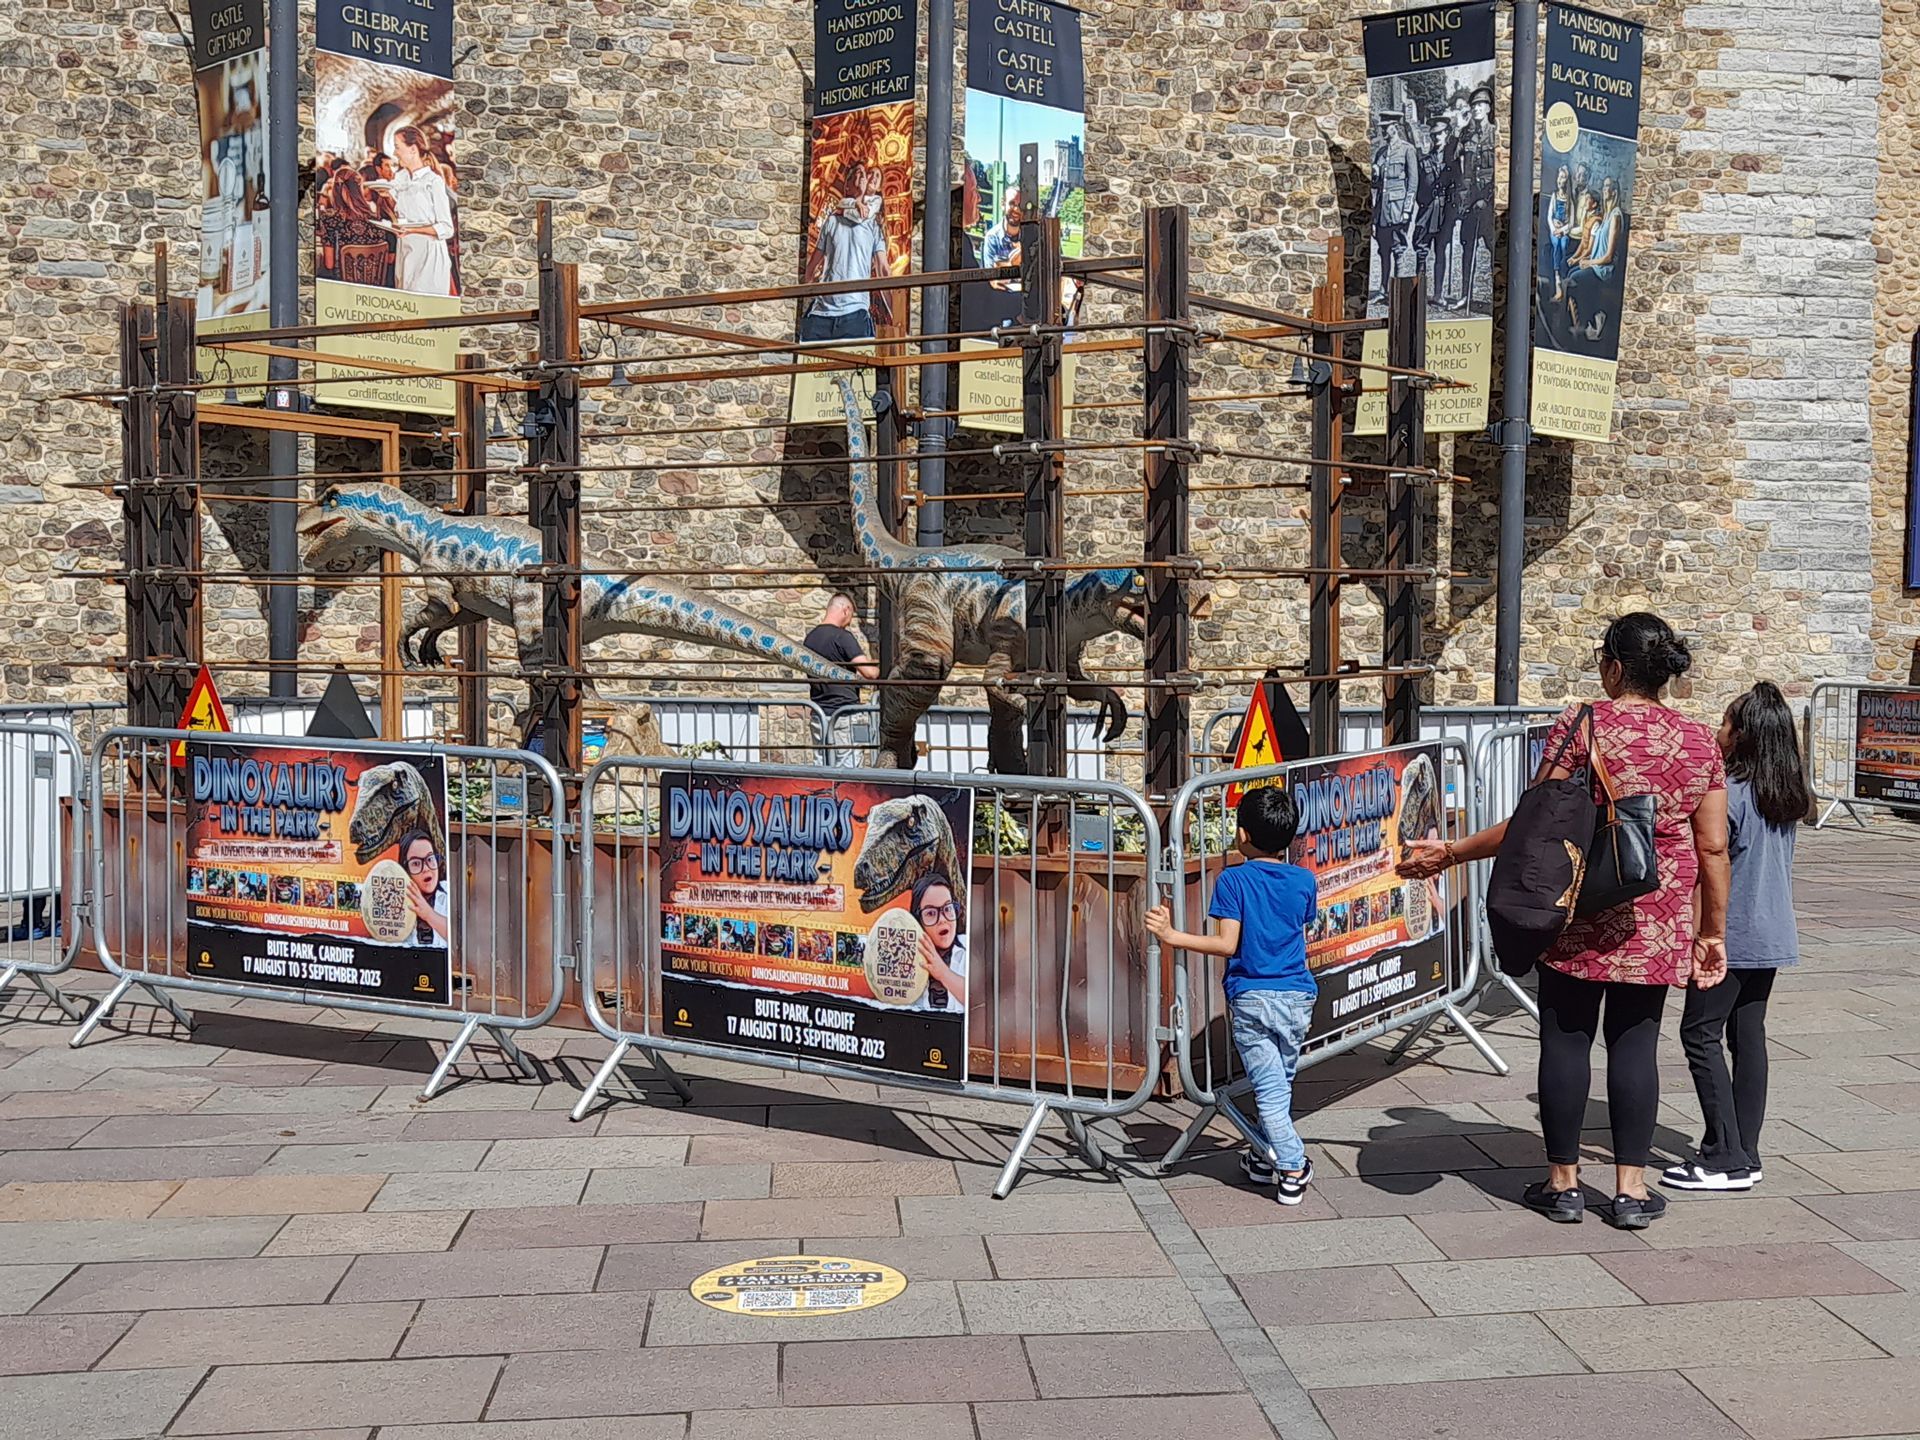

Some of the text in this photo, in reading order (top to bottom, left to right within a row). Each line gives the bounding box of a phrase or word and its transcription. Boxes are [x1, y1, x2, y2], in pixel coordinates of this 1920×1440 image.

[211, 5, 244, 30] CASTLE
[342, 6, 430, 42] CELEBRATE
[828, 5, 904, 34] HANESYDDOL
[1396, 8, 1461, 37] FIRING
[1559, 8, 1633, 43] HANESION Y
[208, 26, 252, 56] GIFT SHOP
[835, 27, 894, 52] CAERDYDD
[994, 16, 1056, 47] CASTELL
[352, 31, 421, 62] IN STYLE
[1410, 38, 1452, 63] LINE
[1600, 42, 1619, 61] DU
[838, 58, 891, 82] CARDIFF'S
[997, 48, 1053, 76] CASTLE
[820, 75, 910, 106] HISTORIC HEART
[1005, 74, 1044, 97] CAFÉ
[1552, 63, 1633, 98] BLACK TOWER
[1574, 91, 1608, 114] TALES
[1445, 328, 1466, 340] 300
[1435, 343, 1472, 355] HANES
[1474, 343, 1483, 354] Y
[1426, 358, 1468, 371] YMREIG
[347, 388, 428, 404] cardiffcastle.com
[815, 391, 834, 403] BUY
[969, 391, 1017, 408] FIND OUT
[1362, 402, 1376, 412] OF
[1440, 398, 1483, 410] SOLDIER
[1434, 412, 1472, 424] TICKET
[1536, 402, 1549, 413] ASK
[1550, 404, 1572, 416] ABOUT
[1572, 407, 1587, 418] OUR
[1539, 416, 1547, 426] AT
[1548, 416, 1560, 429] THE
[1561, 418, 1581, 431] TICKET
[193, 755, 347, 811] DINOSAURS
[1295, 766, 1395, 836] DINOSAURS
[220, 804, 320, 839] IN THE PARK
[669, 787, 853, 850] DINOSAURS
[1316, 819, 1380, 865] IN THE PARK
[701, 842, 819, 882] IN THE PARK
[688, 888, 699, 900] AN
[700, 888, 741, 903] ADVENTURE
[760, 891, 773, 904] THE
[195, 905, 211, 918] BOOK
[212, 907, 227, 920] YOUR
[227, 909, 248, 922] TICKETS
[249, 911, 263, 923] NOW
[266, 939, 355, 965] BUTE PARK, CARDIFF
[243, 956, 382, 987] 17 AUGUST TO 3 SEPTEMBER 2023
[671, 956, 849, 990] BOOK YOUR TICKETS NOW DINOSAURSINTHEPARK.CO.UK
[1348, 969, 1362, 991] BUTE
[1380, 955, 1402, 978] CARDIFF
[894, 989, 907, 998] ME
[1339, 991, 1361, 1016] AUGUST
[1361, 988, 1369, 1007] TO
[1373, 975, 1403, 1002] SEPTEMBER
[1403, 970, 1417, 991] 2023
[755, 998, 856, 1031] BUTE PARK, CARDIFF
[727, 1016, 885, 1060] 17 AUGUST TO 3 SEPTEMBER 2023
[736, 1274, 814, 1282] TALKING
